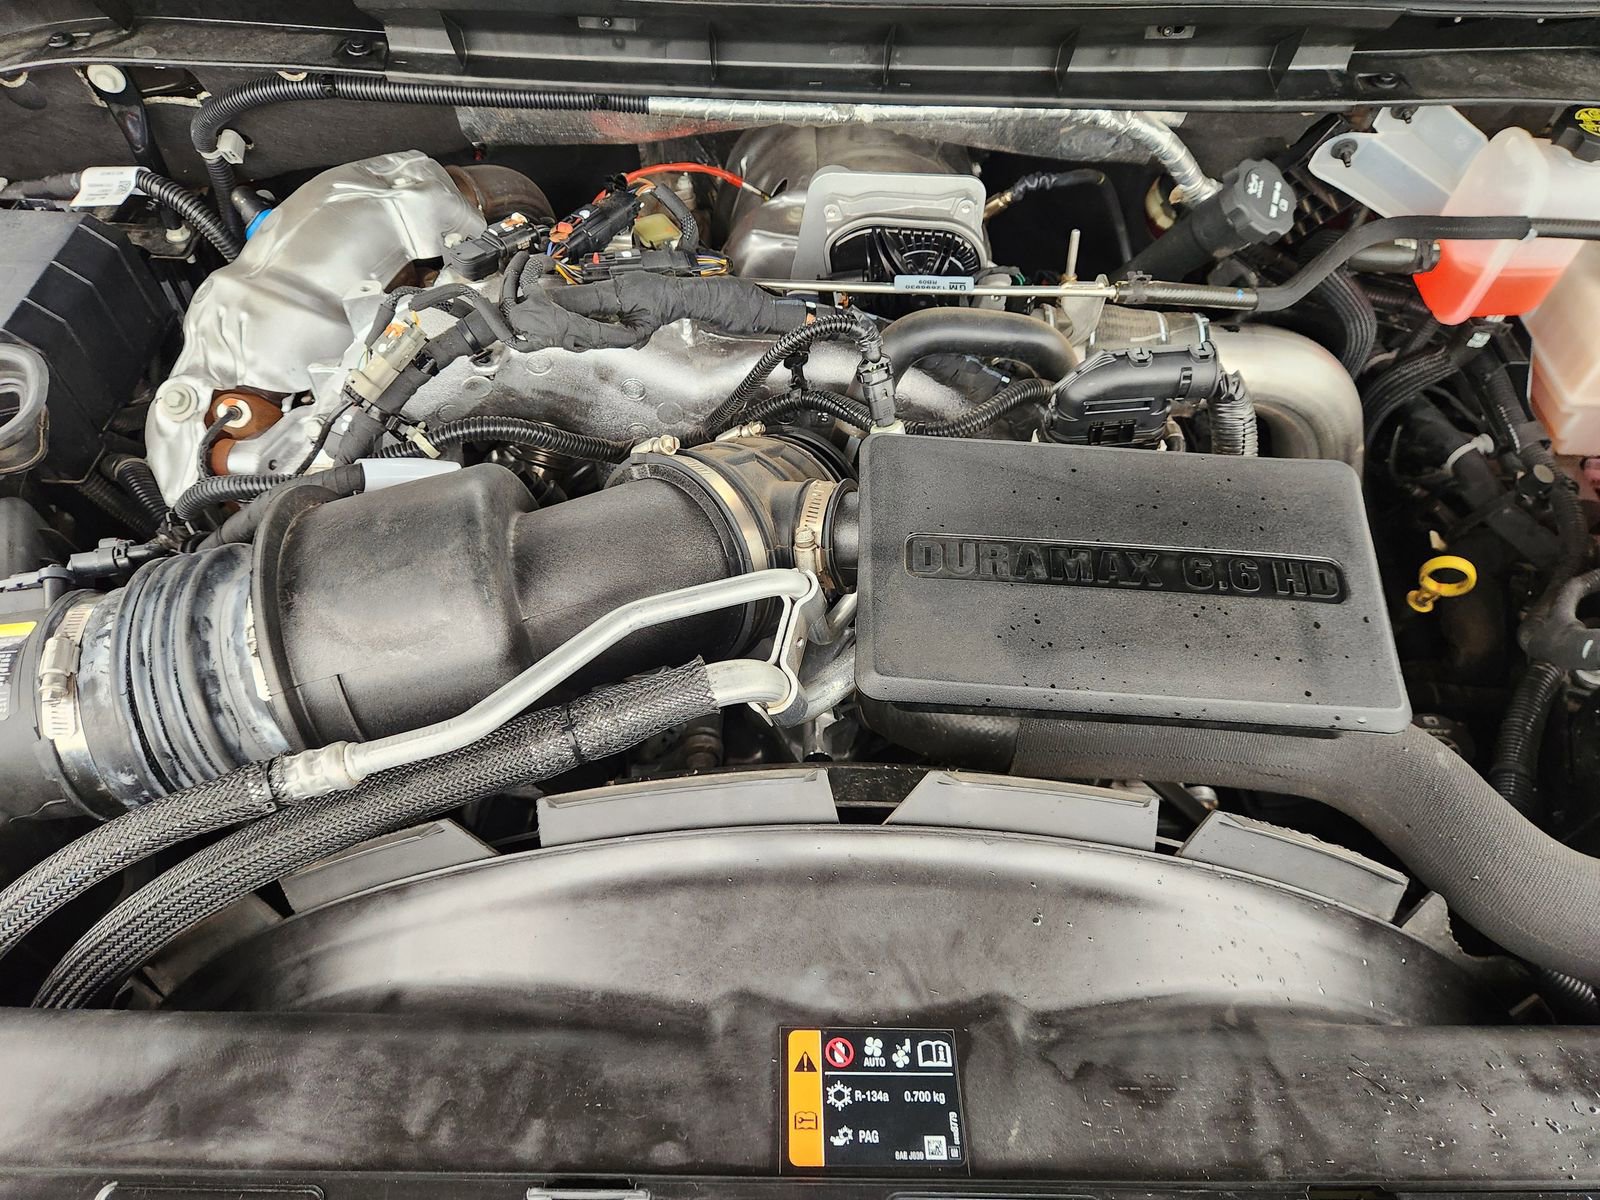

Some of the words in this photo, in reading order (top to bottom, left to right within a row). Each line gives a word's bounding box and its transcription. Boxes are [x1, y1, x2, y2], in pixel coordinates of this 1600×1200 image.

[911, 540, 1164, 587] DURAMAX
[1183, 556, 1263, 594] 6.6
[1272, 560, 1342, 599] HD
[863, 1057, 886, 1068] AUTO
[854, 1091, 890, 1102] R-134a
[904, 1090, 932, 1103] 0.700
[932, 1091, 946, 1105] kg
[858, 1130, 880, 1144] PAG
